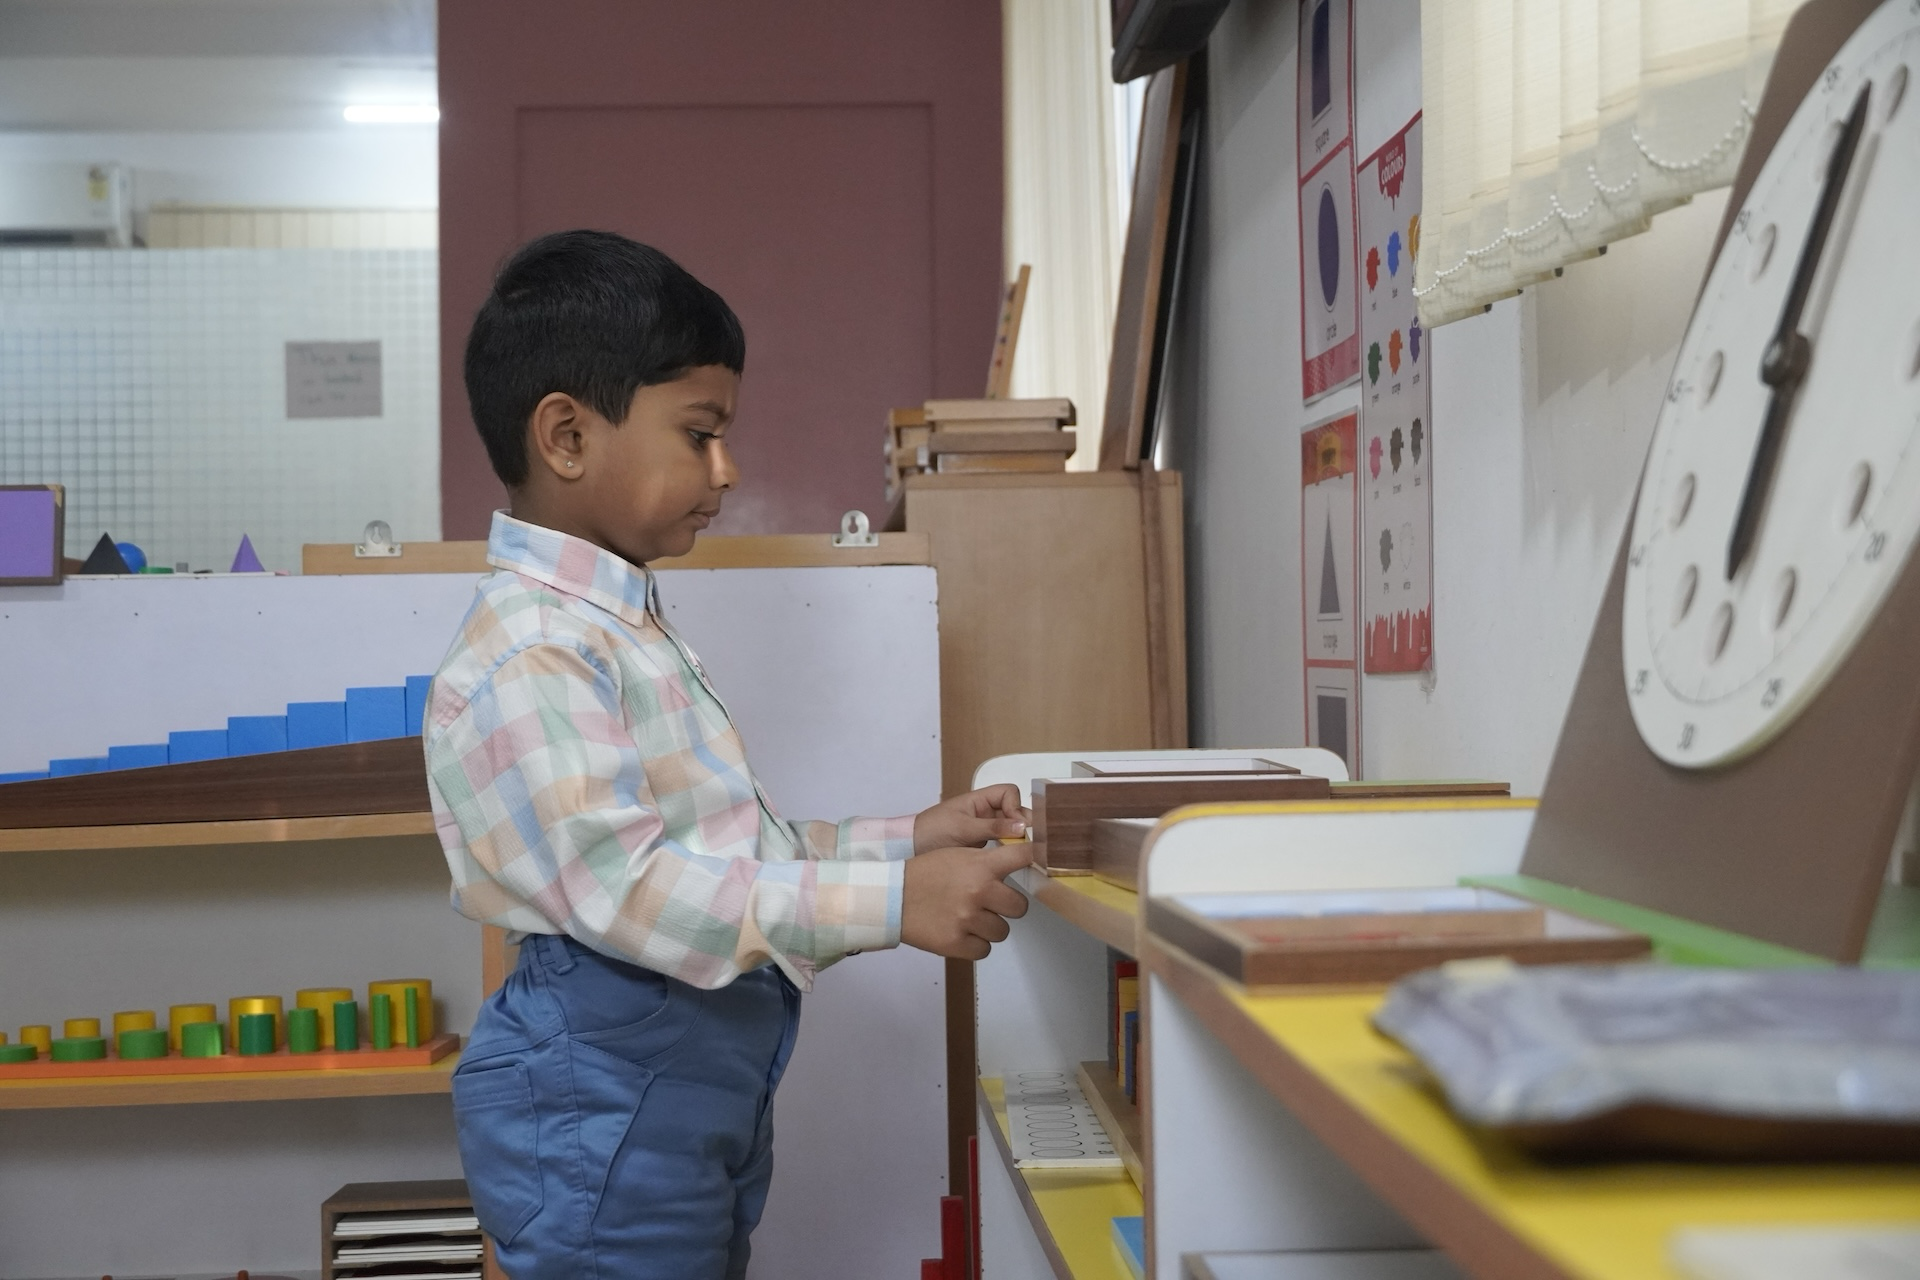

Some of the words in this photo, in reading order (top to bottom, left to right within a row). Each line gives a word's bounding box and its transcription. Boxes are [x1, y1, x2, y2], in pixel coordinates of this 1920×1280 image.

[1381, 153, 1404, 185] COLOURS
[1863, 532, 1886, 563] 20
[1629, 669, 1649, 696] 35
[1759, 677, 1784, 709] 25
[1676, 722, 1695, 751] 30
